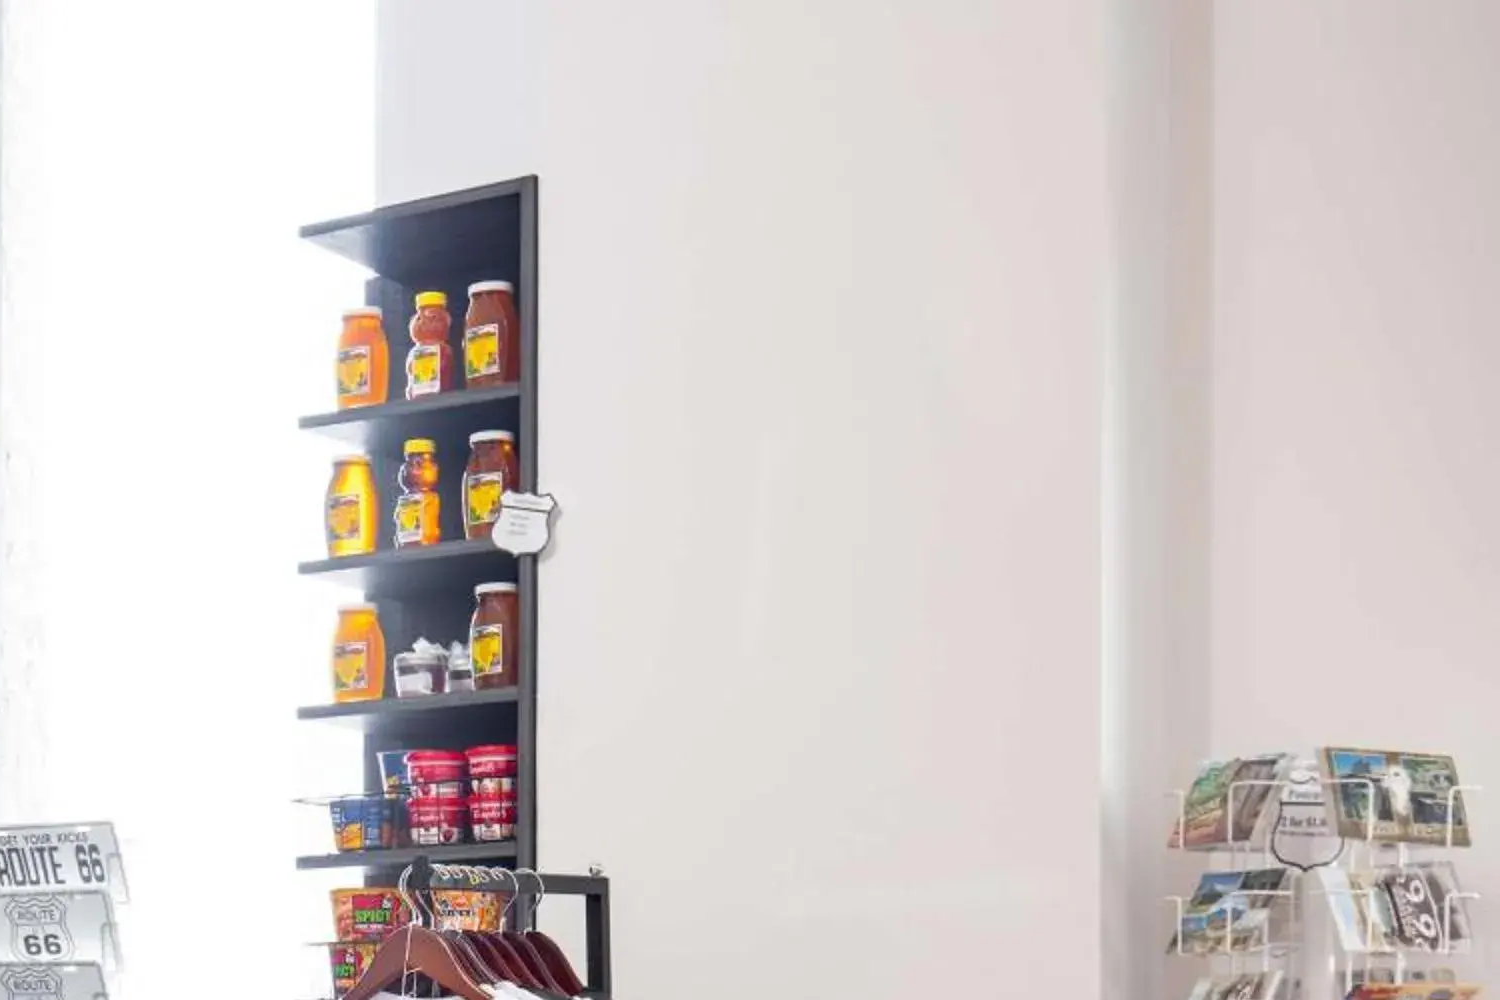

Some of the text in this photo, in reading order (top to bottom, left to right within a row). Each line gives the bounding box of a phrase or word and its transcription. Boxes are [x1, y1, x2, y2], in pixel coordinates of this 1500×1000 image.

[23, 834, 52, 845] YOUR
[57, 832, 89, 844] KICKS
[75, 844, 105, 883] 66
[17, 909, 57, 921] ROUTE
[23, 934, 63, 956] 66
[13, 979, 52, 991] ROUTE
